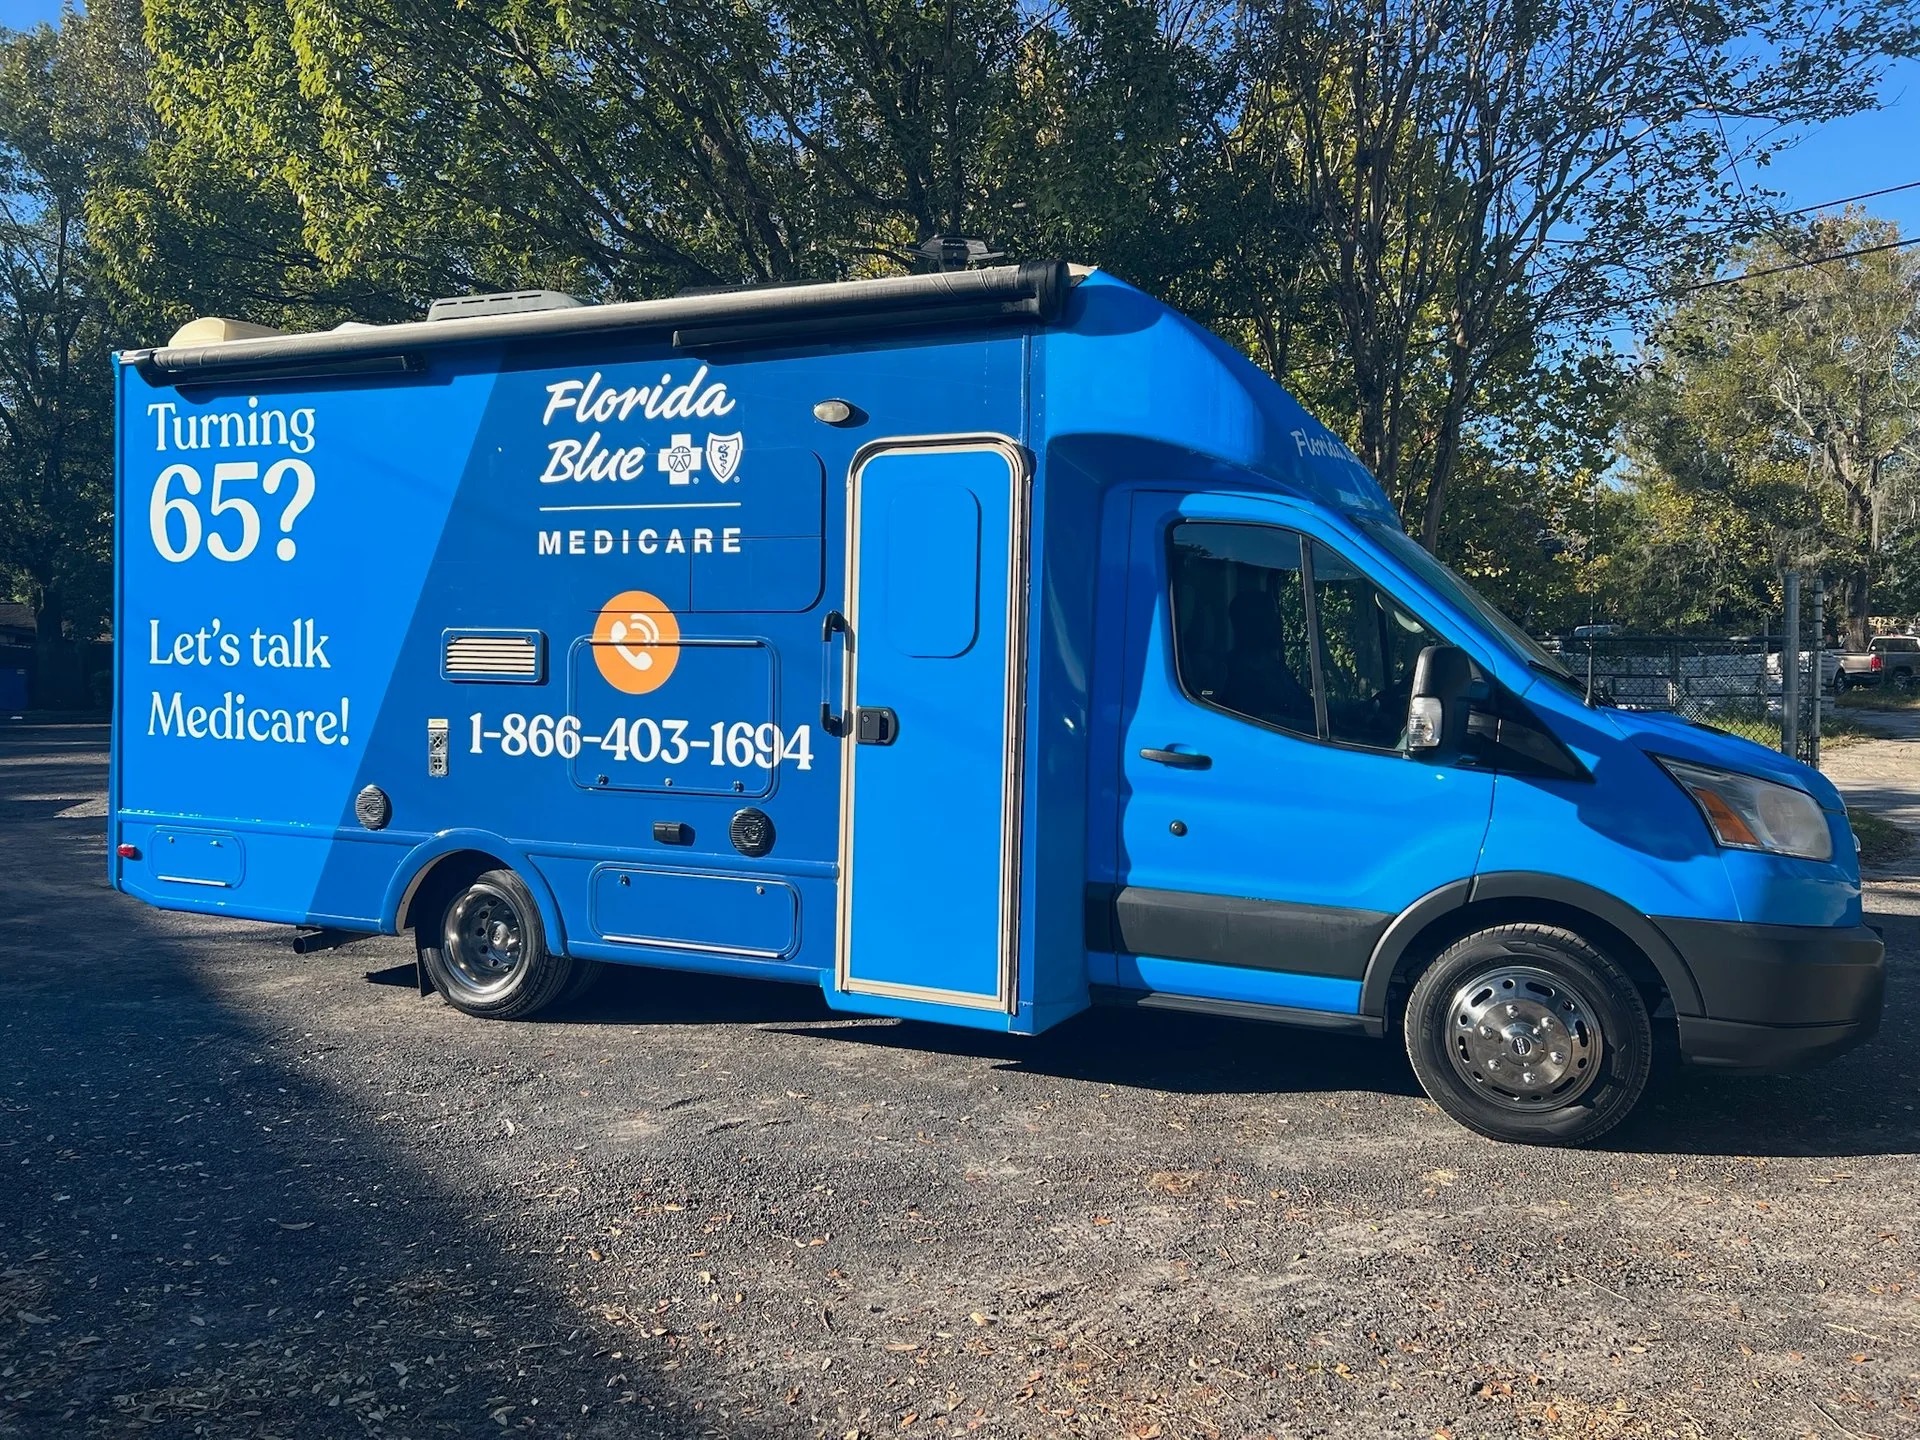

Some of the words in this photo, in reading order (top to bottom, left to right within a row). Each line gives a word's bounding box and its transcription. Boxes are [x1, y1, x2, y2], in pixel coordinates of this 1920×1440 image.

[542, 365, 736, 426] Florida
[148, 396, 315, 454] Turning
[539, 431, 645, 483] Blue
[149, 458, 316, 563] 65?
[538, 527, 742, 555] MEDICARE
[149, 618, 240, 666] Let's
[250, 618, 331, 669] talk
[148, 691, 349, 746] Medicare!
[469, 712, 814, 770] 1-866-403-1694
